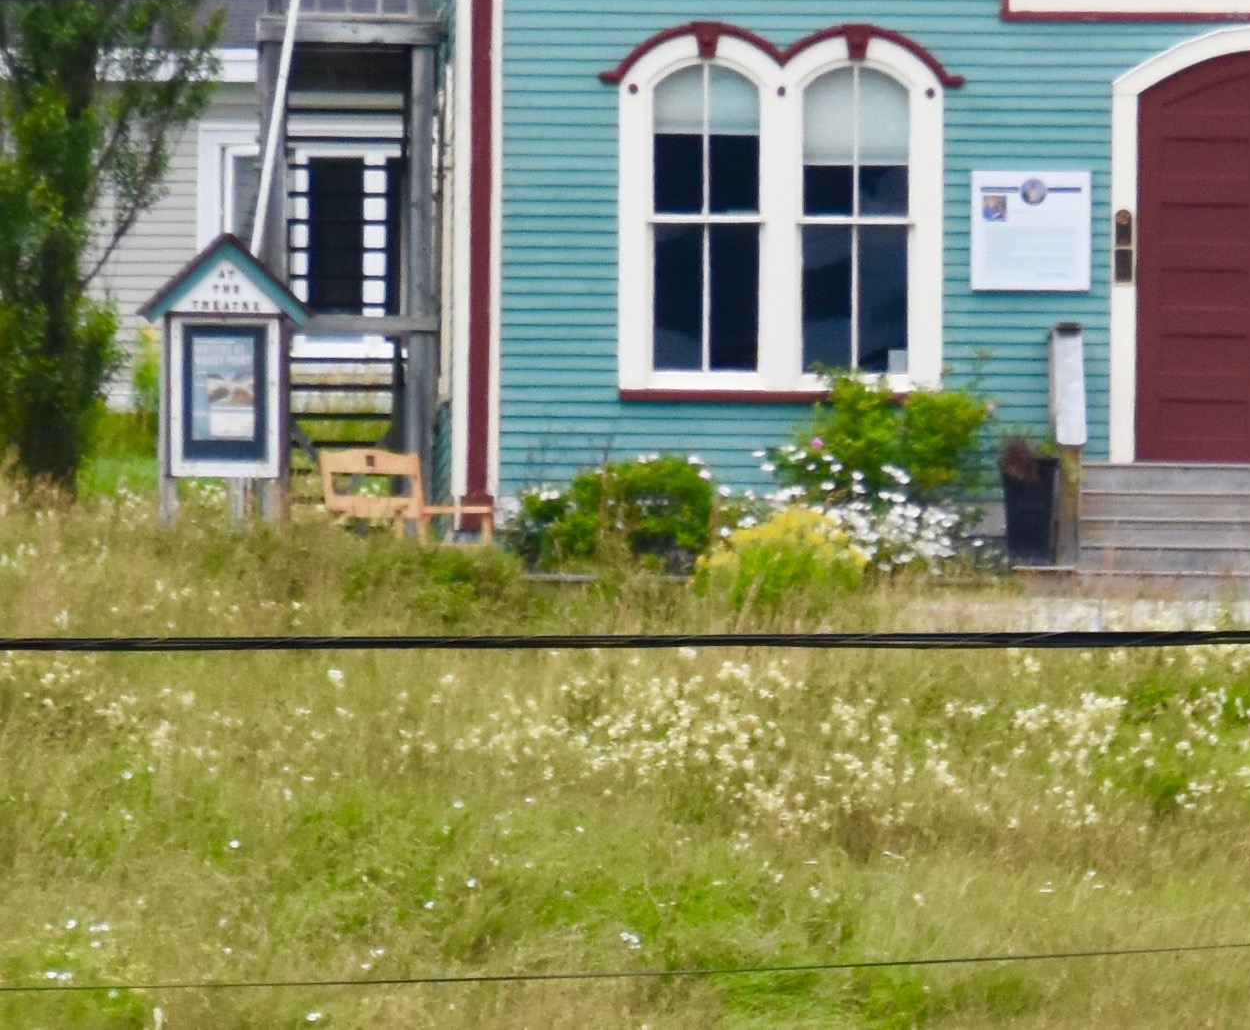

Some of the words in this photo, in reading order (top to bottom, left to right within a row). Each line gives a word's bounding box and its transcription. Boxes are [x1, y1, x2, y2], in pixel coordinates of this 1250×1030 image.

[219, 270, 235, 279] AT
[213, 284, 240, 294] THE
[193, 300, 259, 311] THEATRE
